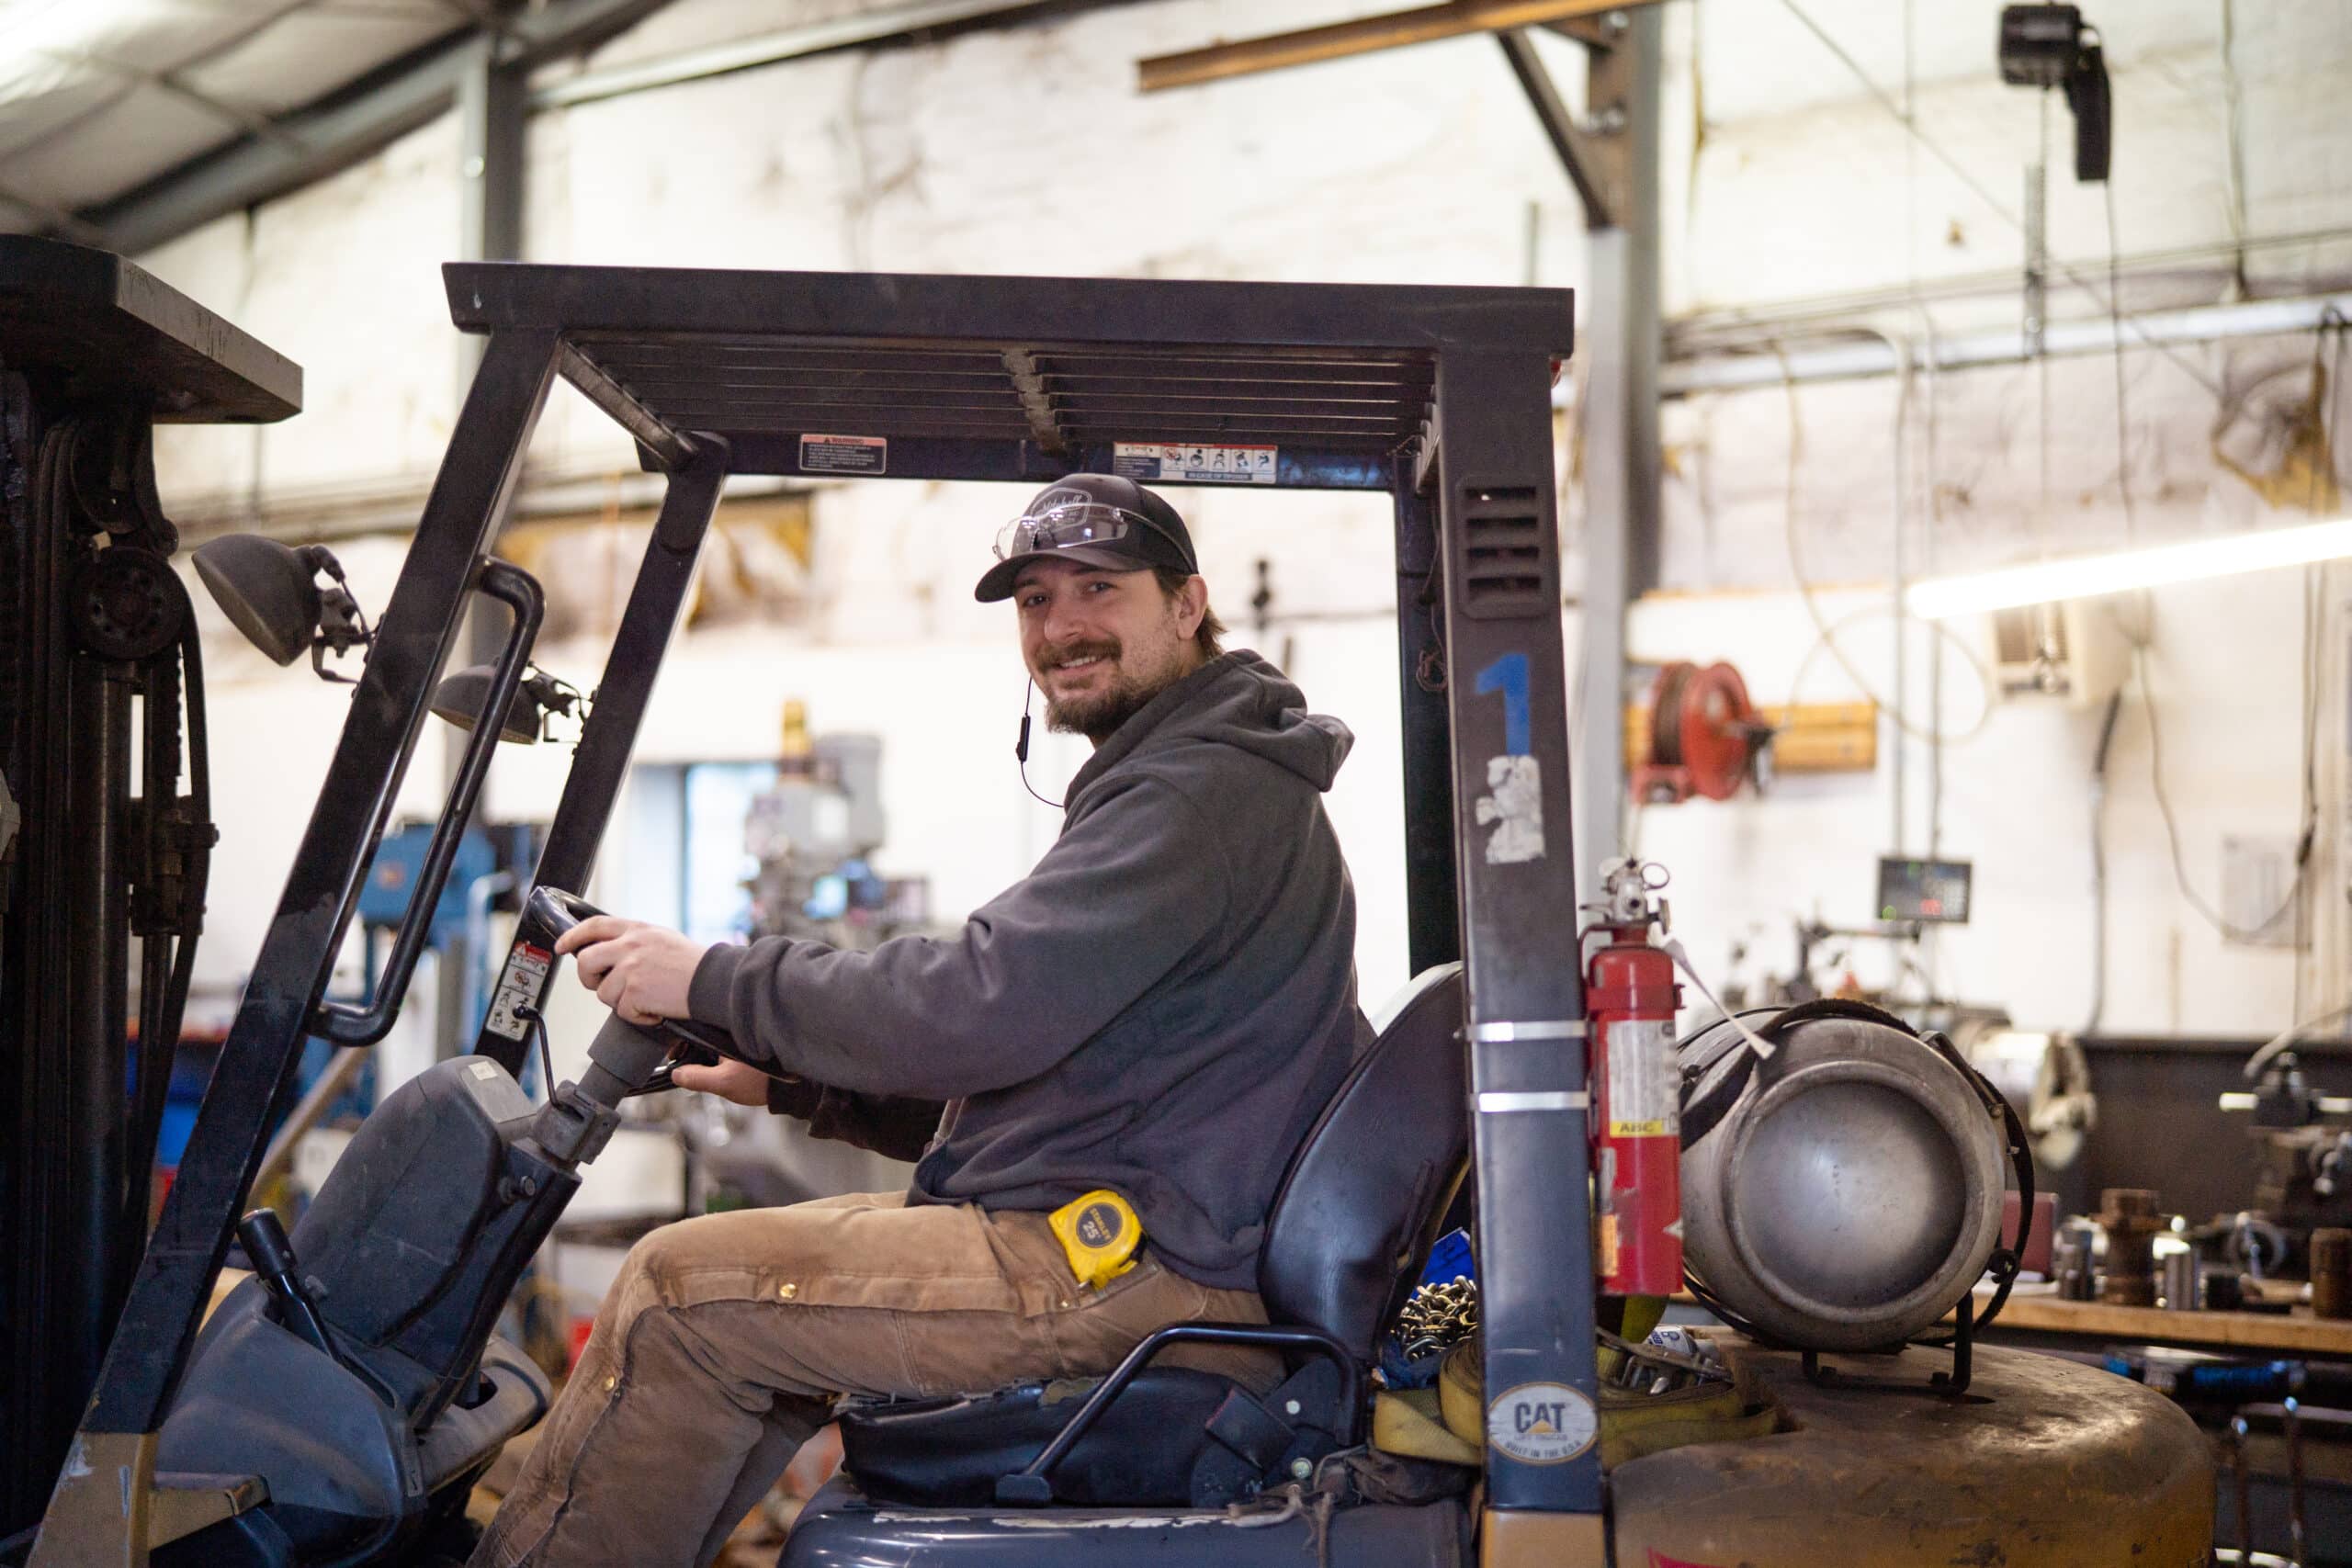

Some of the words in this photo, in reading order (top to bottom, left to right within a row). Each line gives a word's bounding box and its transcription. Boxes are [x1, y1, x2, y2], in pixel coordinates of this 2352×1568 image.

[1476, 652, 1531, 757] 1
[1619, 1121, 1655, 1134] ABC
[1090, 1207, 1113, 1241] STANLEY
[1514, 1403, 1566, 1434] CAT
[1505, 1440, 1528, 1455] BUILT
[1530, 1448, 1541, 1458] IN
[1544, 1449, 1559, 1459] THE
